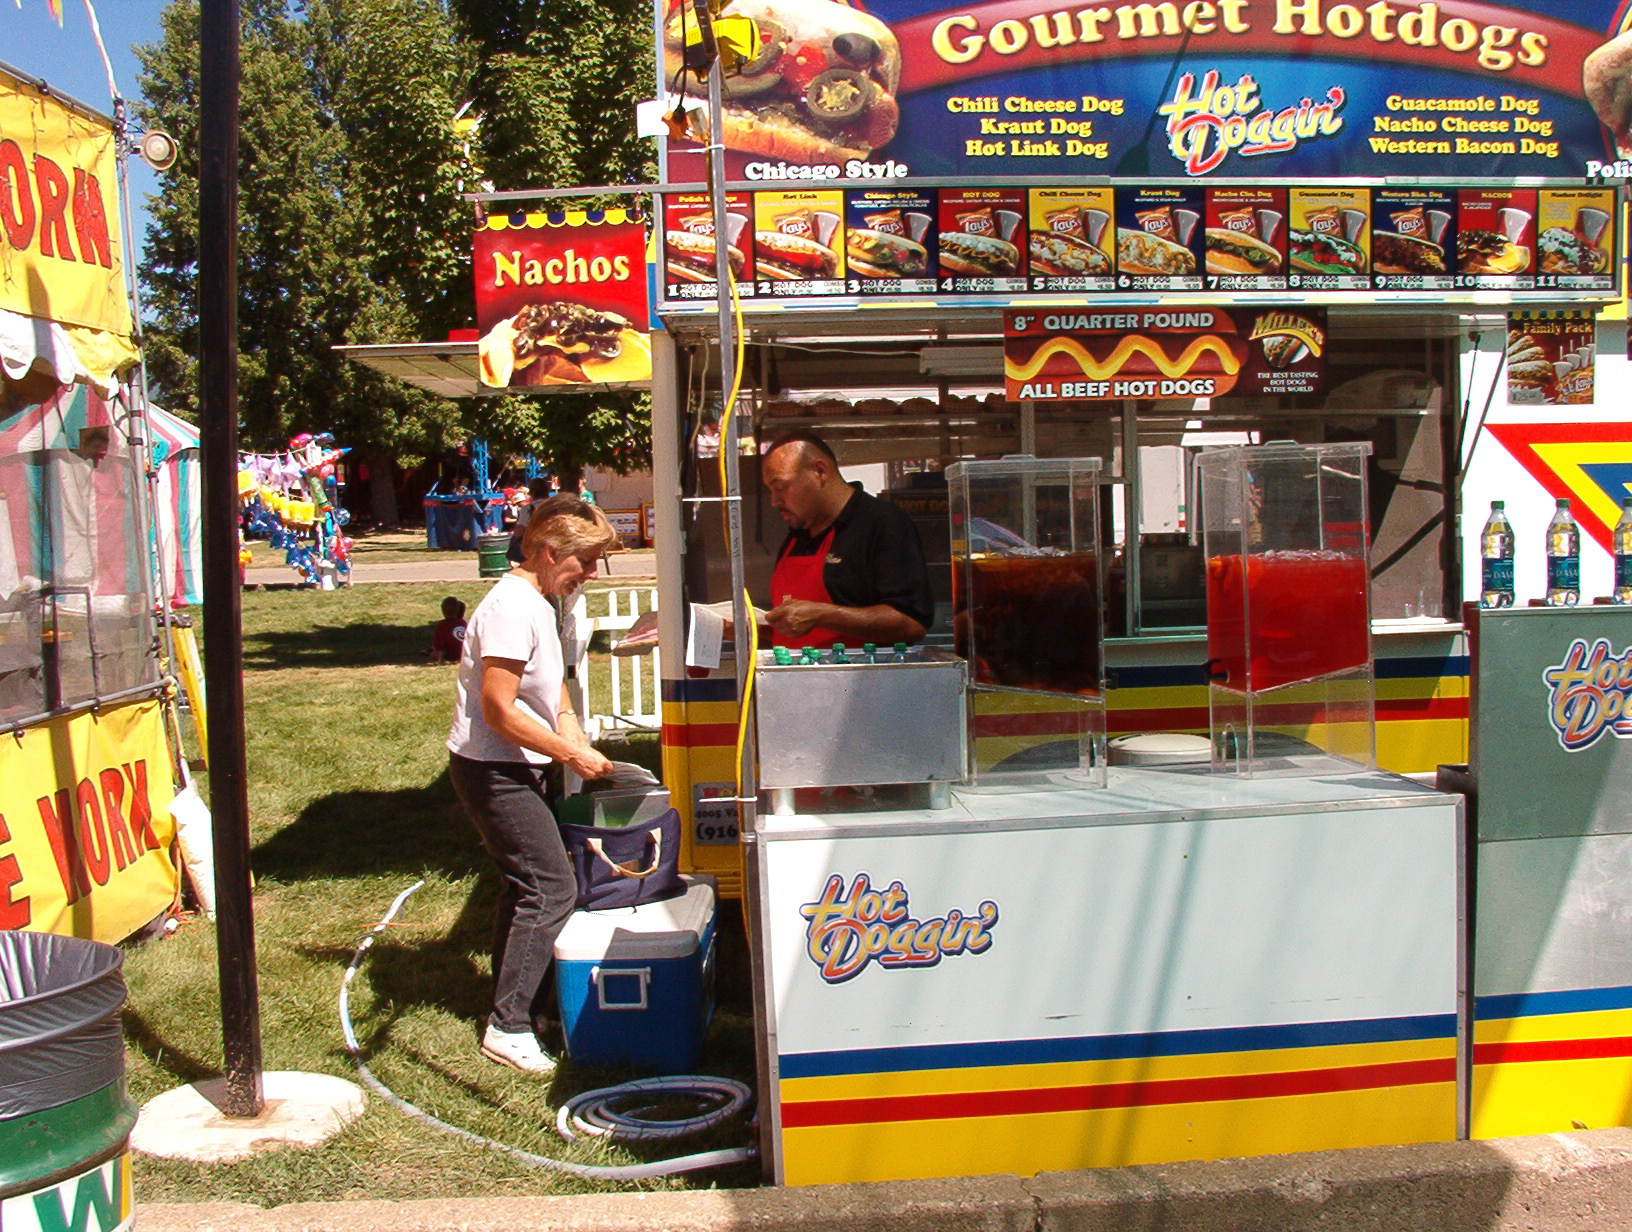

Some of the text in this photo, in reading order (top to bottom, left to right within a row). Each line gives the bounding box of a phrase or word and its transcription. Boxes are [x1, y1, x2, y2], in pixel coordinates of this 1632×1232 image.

[931, 0, 1548, 70] Gourmet Hotdogs
[946, 96, 1124, 115] Chili Cheese Dog
[1158, 70, 1261, 134] Hot
[1386, 95, 1540, 115] Guacamole Dog
[980, 118, 1092, 138] Kraut Dog
[1171, 86, 1345, 175] Doggin'
[1373, 116, 1553, 136] Nacho Cheese Dog
[965, 140, 1109, 159] Hot Link Dog
[1368, 137, 1559, 158] Western Bacon Dog
[744, 159, 909, 180] Chicago Style
[1586, 161, 1632, 178] Poli
[0, 138, 112, 269] ORN
[492, 249, 631, 287] Nachos
[667, 284, 679, 297] 1
[758, 281, 772, 294] 2
[847, 280, 861, 293] 3
[941, 277, 953, 291] 4
[1033, 277, 1045, 290] 5
[1118, 275, 1131, 288] 6
[1206, 276, 1219, 289] 7
[1289, 275, 1301, 287] 8
[1375, 276, 1387, 288] 9
[1454, 276, 1475, 287] 10
[1536, 275, 1556, 287] 11
[1014, 311, 1215, 331] 8" QUARTER POUND
[1523, 320, 1593, 335] Family Pack
[1019, 379, 1215, 398] ALL BEEF HOT DOGS
[696, 822, 738, 840] (916
[801, 874, 908, 938] Hot
[809, 900, 998, 983] Doggin'
